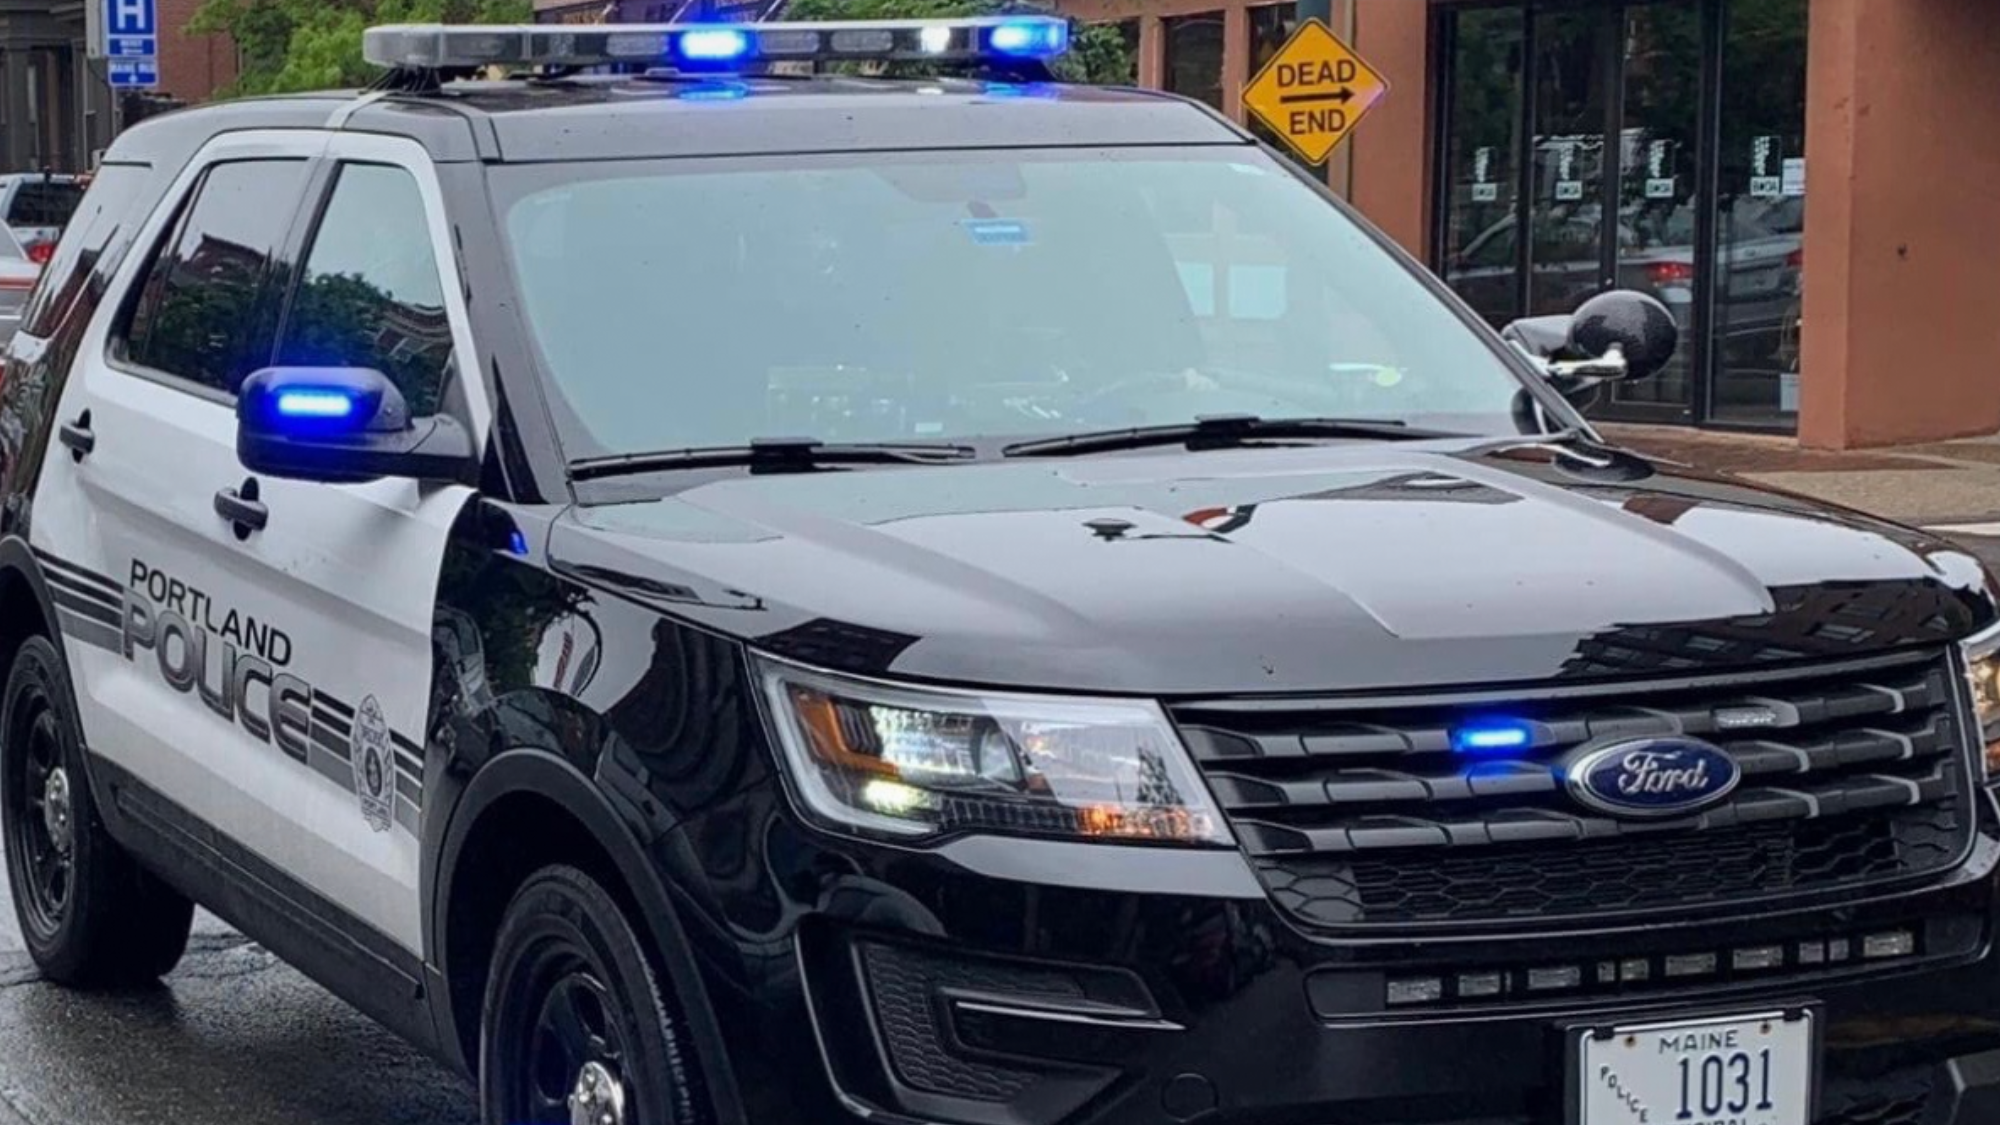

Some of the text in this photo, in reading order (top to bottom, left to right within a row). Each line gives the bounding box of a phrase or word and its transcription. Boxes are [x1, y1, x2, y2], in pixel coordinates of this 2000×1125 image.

[116, 0, 146, 30] H
[1277, 59, 1356, 87] DEAD
[1290, 109, 1346, 135] END
[130, 558, 292, 667] PORTLAND
[122, 586, 313, 766] POLICE
[1617, 750, 1709, 795] Ford
[1658, 1029, 1740, 1054] MAINE
[1600, 1065, 1649, 1123] POLICE
[1676, 1048, 1773, 1120] 1031
